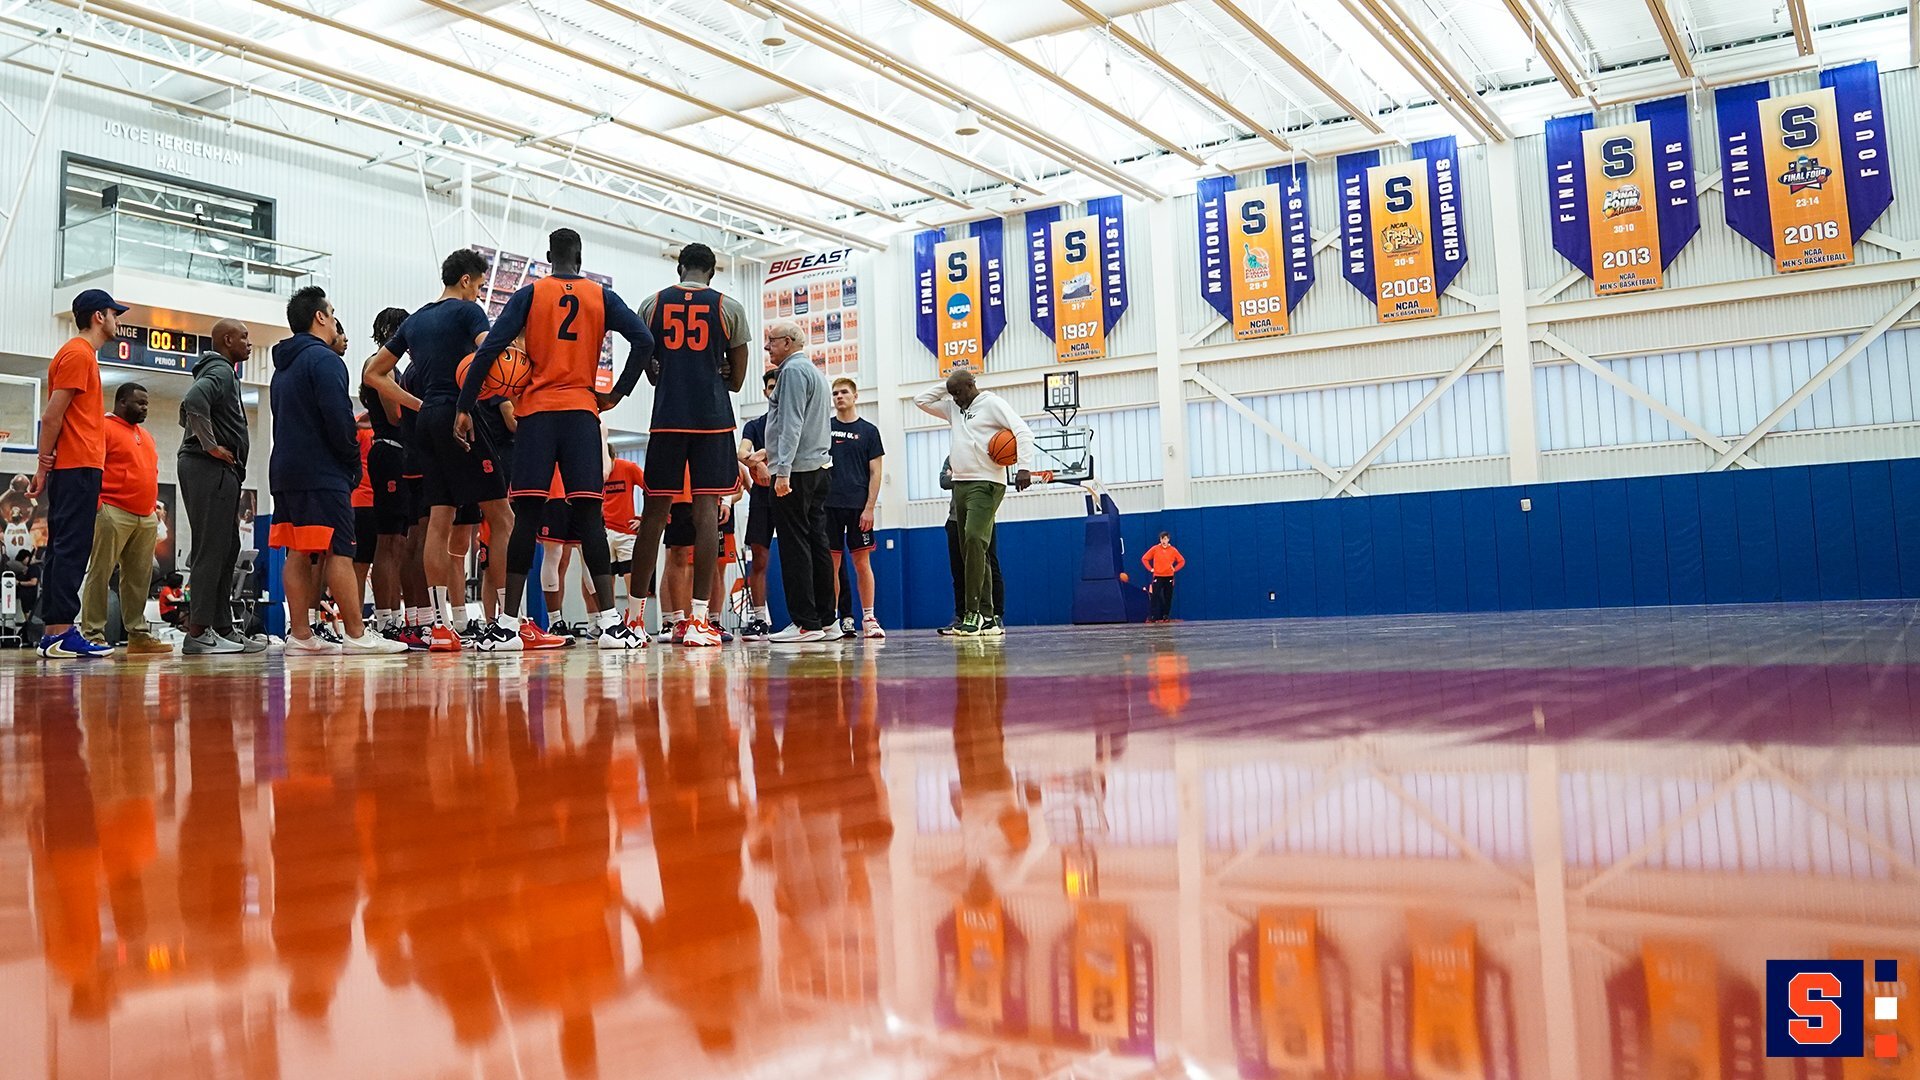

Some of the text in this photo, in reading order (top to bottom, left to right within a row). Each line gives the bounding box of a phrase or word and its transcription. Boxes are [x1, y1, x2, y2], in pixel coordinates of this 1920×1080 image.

[1780, 105, 1819, 150] S
[102, 120, 243, 165] JOYCE HERGENHAN
[1854, 109, 1880, 178] FOUR
[156, 154, 191, 175] HALL
[1602, 136, 1636, 178] S
[1730, 131, 1750, 197] FINAL
[1666, 142, 1688, 206] FOUR
[1784, 168, 1826, 182] FINAL FOUR
[1384, 174, 1414, 214] S
[1557, 160, 1576, 222] FINAL
[1613, 190, 1638, 200] FINAL
[1436, 158, 1460, 261] CHAMPIONS
[1604, 198, 1638, 210] FOUR
[1796, 196, 1820, 208] 23-14
[1241, 199, 1268, 236] S
[1346, 174, 1364, 274] NATIONAL
[1390, 222, 1408, 230] NCAA
[1288, 185, 1308, 282] FINALIST
[1614, 224, 1634, 234] 30-10
[1784, 220, 1839, 245] 2016
[1064, 228, 1087, 264] S
[1204, 198, 1222, 293] NATIONAL
[1804, 248, 1822, 256] NCAA
[948, 251, 968, 283] S
[1106, 216, 1122, 306] FINALIST
[1602, 248, 1651, 269] 2013
[1782, 253, 1846, 268] MEN'S BASKETBALL
[802, 268, 848, 279] CONFERENCE
[988, 259, 1001, 306] FOUR
[1033, 228, 1048, 318] NATIONAL
[1620, 278, 1656, 288] BASKETBALL
[921, 269, 932, 314] FINAL
[1381, 276, 1432, 299] 2003
[949, 304, 970, 315] NCAA
[1240, 296, 1281, 316] 1996
[1396, 300, 1418, 310] NCAA
[1400, 308, 1433, 316] BASKETBALL
[558, 294, 579, 341] 2
[663, 304, 710, 351] 55
[1250, 319, 1271, 328] NCAA
[116, 326, 138, 338] ANGE
[1062, 321, 1098, 340] 1987
[1254, 326, 1284, 334] BASKETBALL
[944, 338, 978, 356] 1975
[1070, 342, 1090, 352] NCAA
[155, 356, 186, 368] PERIOD 1
[952, 359, 969, 367] NCAA
[482, 460, 494, 473] S
[387, 480, 396, 492] S
[11, 536, 24, 546] 40
[542, 526, 550, 536] S
